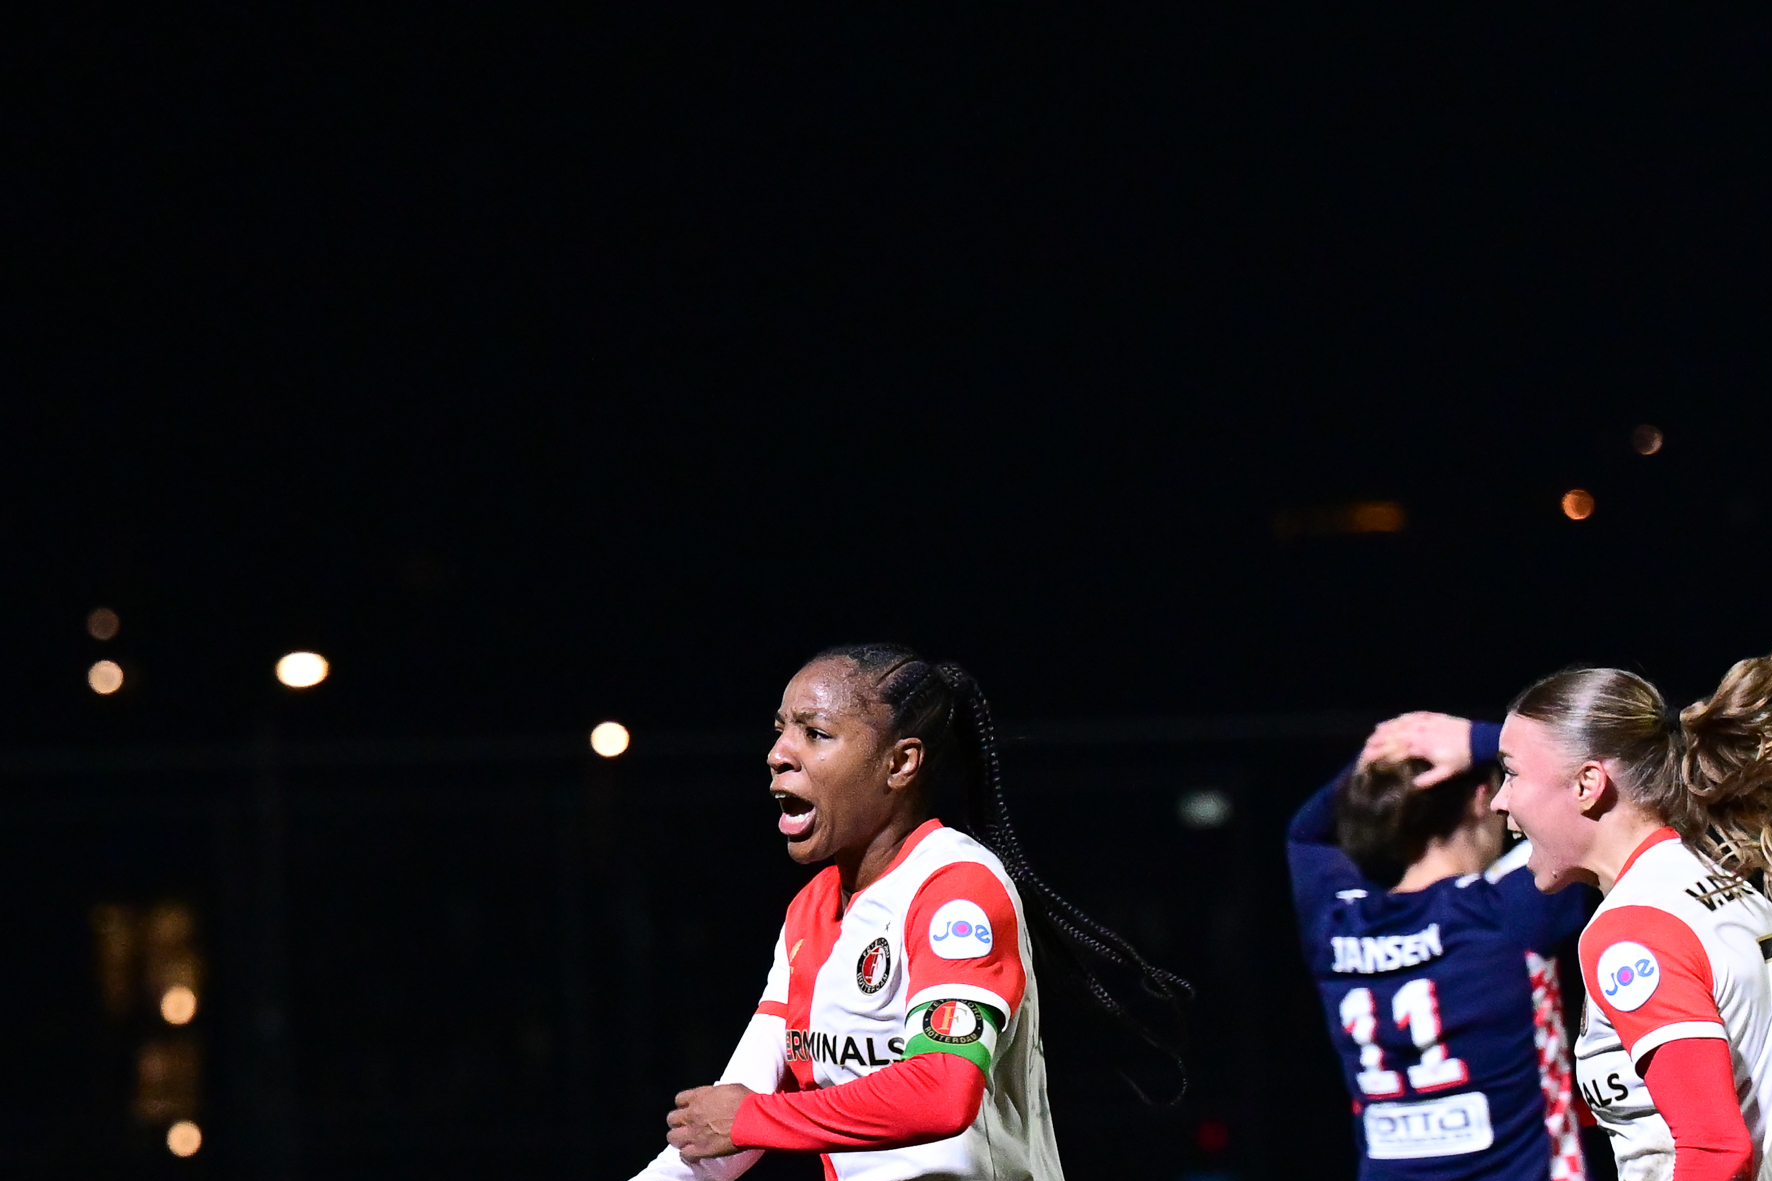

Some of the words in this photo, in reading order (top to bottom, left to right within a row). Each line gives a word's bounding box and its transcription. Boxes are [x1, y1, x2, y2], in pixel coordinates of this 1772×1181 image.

[1330, 922, 1444, 975] JANSEN
[784, 1029, 906, 1067] ERMINALS
[1338, 977, 1471, 1100] 11
[1582, 1071, 1629, 1109] ALS
